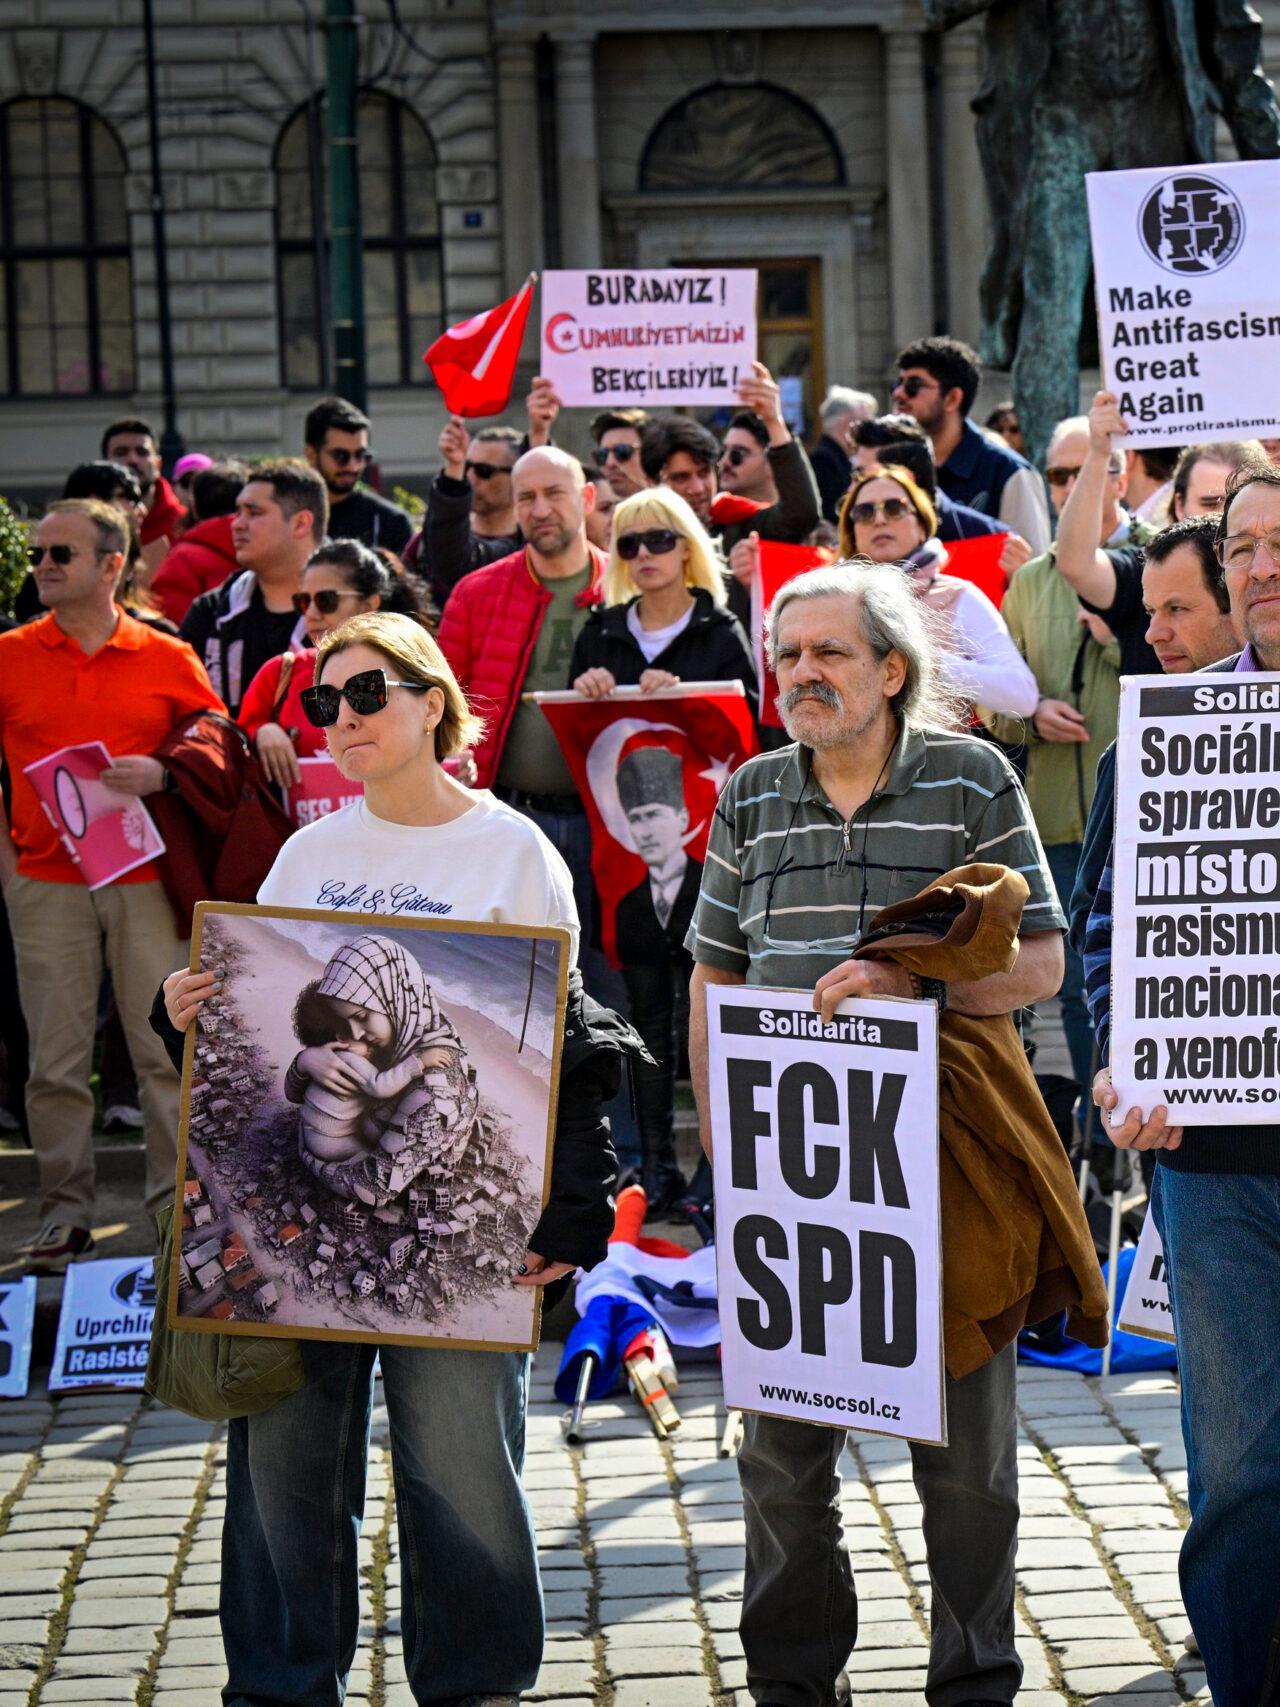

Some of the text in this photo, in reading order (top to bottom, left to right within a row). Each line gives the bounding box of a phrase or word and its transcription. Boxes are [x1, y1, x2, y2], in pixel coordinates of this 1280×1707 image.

[1109, 285, 1192, 312] Make
[1115, 352, 1199, 382] Great
[1119, 388, 1204, 422] Again
[1137, 845, 1278, 897] místo
[316, 879, 367, 912] Café
[363, 889, 385, 914] &
[759, 1009, 881, 1044] Solidarita
[1134, 1036, 1158, 1080] a
[726, 1057, 911, 1210] FCK
[733, 1213, 917, 1369] SPD
[69, 1343, 149, 1373] Rasisté
[760, 1384, 901, 1421] www.socsol.cz
